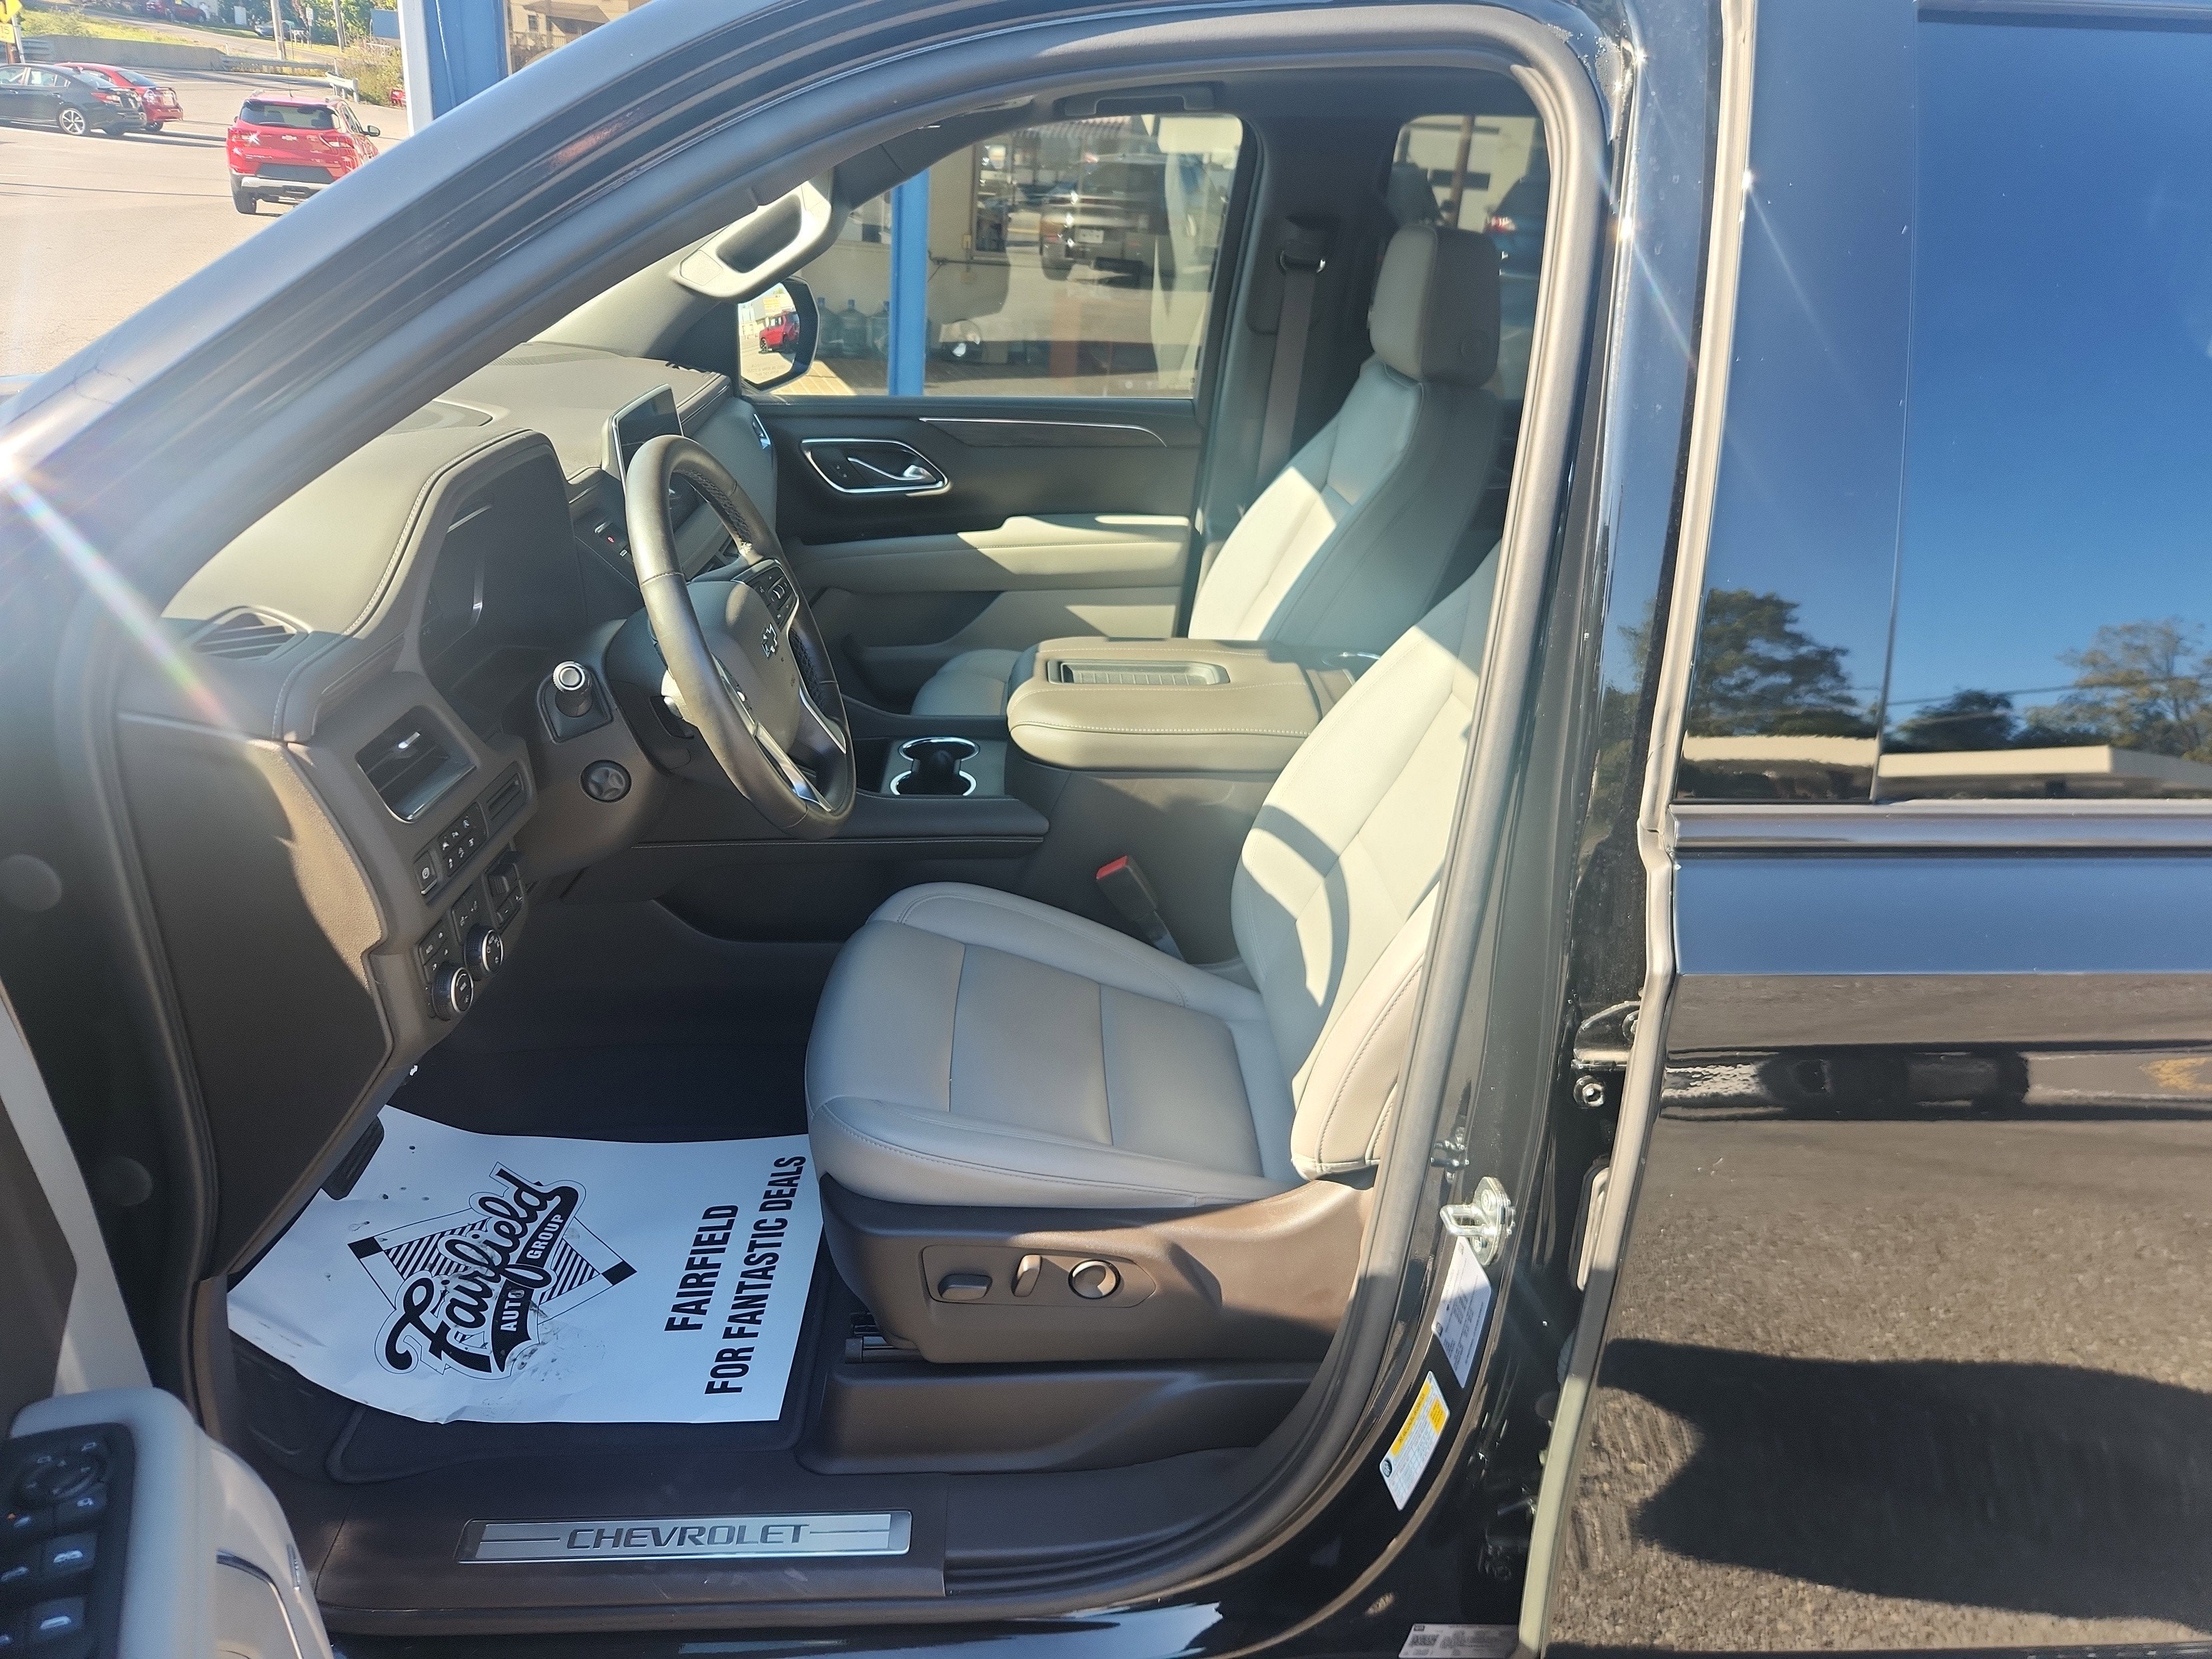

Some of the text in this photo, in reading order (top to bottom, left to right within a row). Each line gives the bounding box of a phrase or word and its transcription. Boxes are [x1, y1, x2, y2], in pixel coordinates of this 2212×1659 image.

[1, 25, 10, 35] 15
[385, 1168, 579, 1374] Fairfield
[500, 1214, 564, 1332] AUTO GROUP
[664, 1205, 738, 1332] FAIRFIELD
[704, 1156, 806, 1394] FOR FANTASTIC DEALS
[566, 1524, 810, 1549] CHEVROLET
